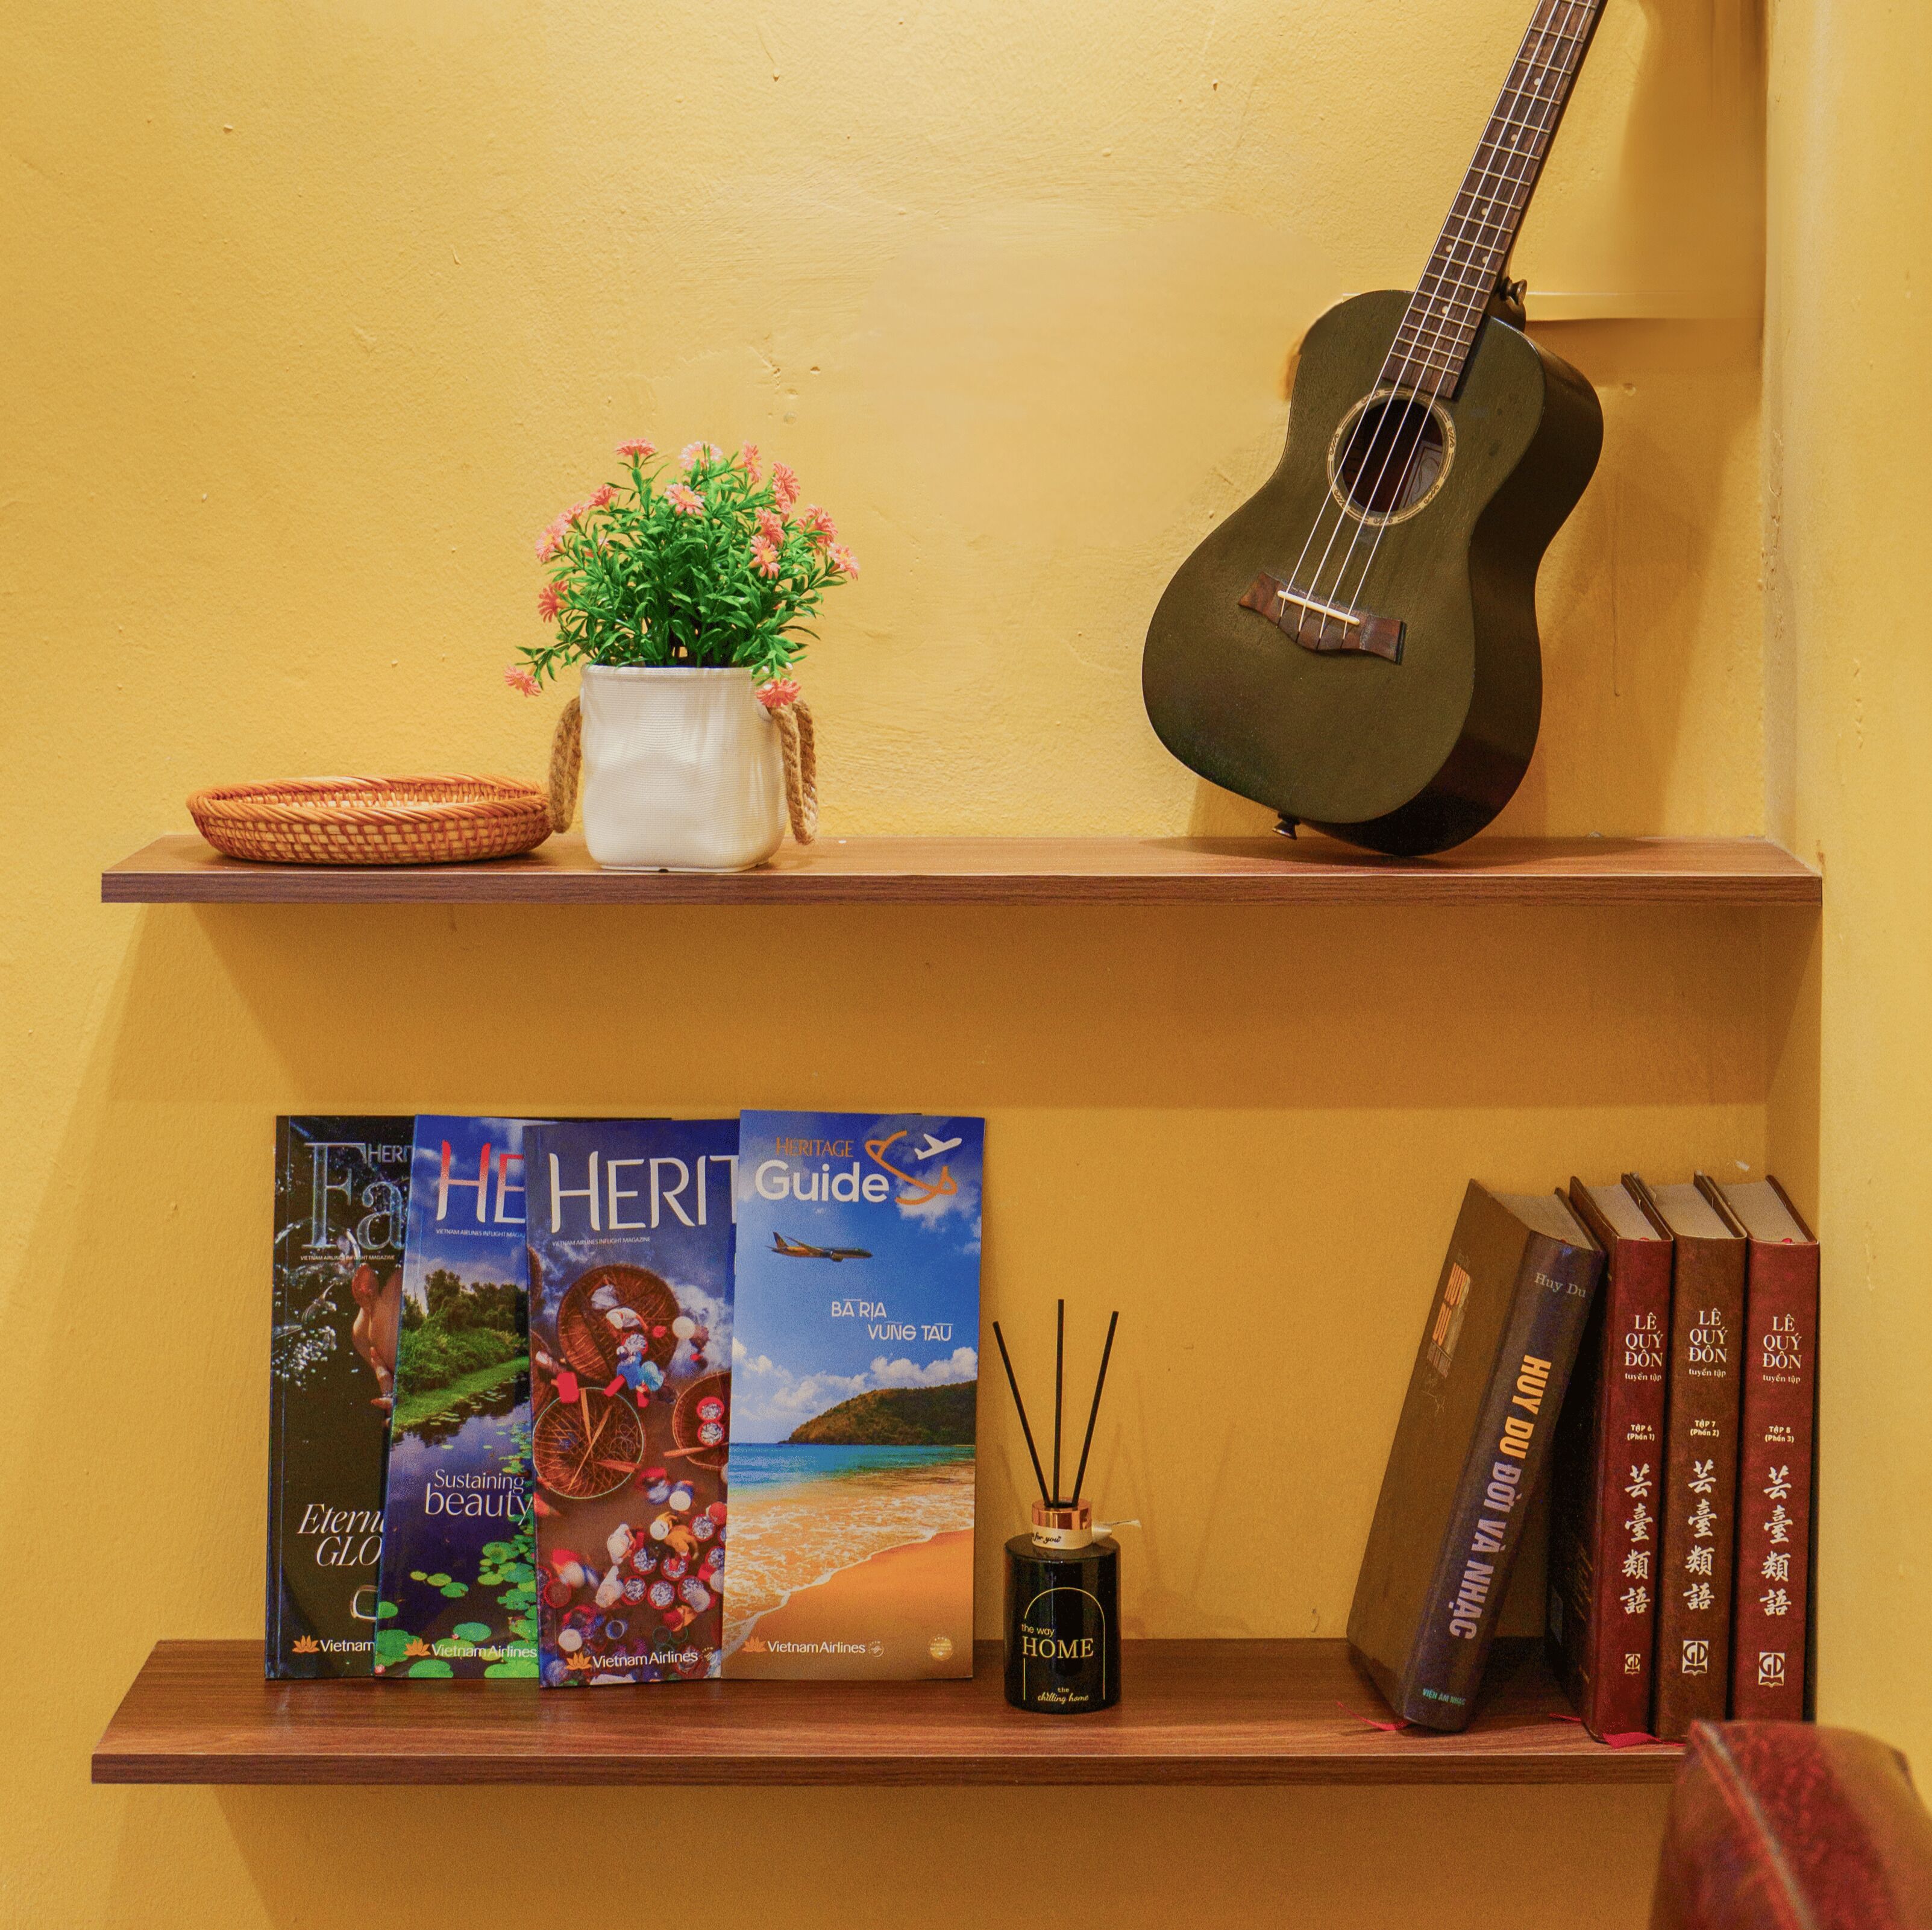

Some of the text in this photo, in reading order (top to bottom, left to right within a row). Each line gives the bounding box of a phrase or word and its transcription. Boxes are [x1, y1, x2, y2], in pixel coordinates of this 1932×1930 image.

[775, 1136, 855, 1158] HERITAGE
[436, 1139, 525, 1224] HE
[755, 1159, 889, 1203] Guide
[1534, 1272, 1586, 1298] Huy Du
[1634, 1312, 1657, 1330] LÊ
[1698, 1307, 1721, 1326] LÊ
[1772, 1313, 1795, 1331] LÊ
[1625, 1330, 1664, 1350] QUÝ
[1689, 1327, 1728, 1346] QUÝ
[1763, 1333, 1802, 1351] QUÝ
[1624, 1349, 1663, 1368] ĐÔN
[1689, 1345, 1728, 1363] ĐÔN
[1762, 1350, 1802, 1369] ĐÔN
[1649, 1373, 1662, 1382] tập
[1713, 1369, 1727, 1378] tập
[1787, 1375, 1801, 1384] tập
[434, 1469, 525, 1495] Sustaining
[425, 1483, 533, 1526] beauty
[1448, 1354, 1552, 1640] HUY DU ĐỜI VÀ NHẠC
[316, 1535, 383, 1567] GLO
[1021, 1623, 1055, 1638] the way
[320, 1639, 375, 1652] Vietnam
[431, 1644, 538, 1658] Vietnam Airlines
[767, 1641, 819, 1653] Vietnam
[819, 1641, 866, 1653] Airlines
[1022, 1635, 1094, 1659] HOME
[1683, 1641, 1708, 1664] GD
[592, 1650, 698, 1668] Vietnam Airlines
[1758, 1653, 1785, 1676] GD
[1038, 1691, 1089, 1705] chilling home
